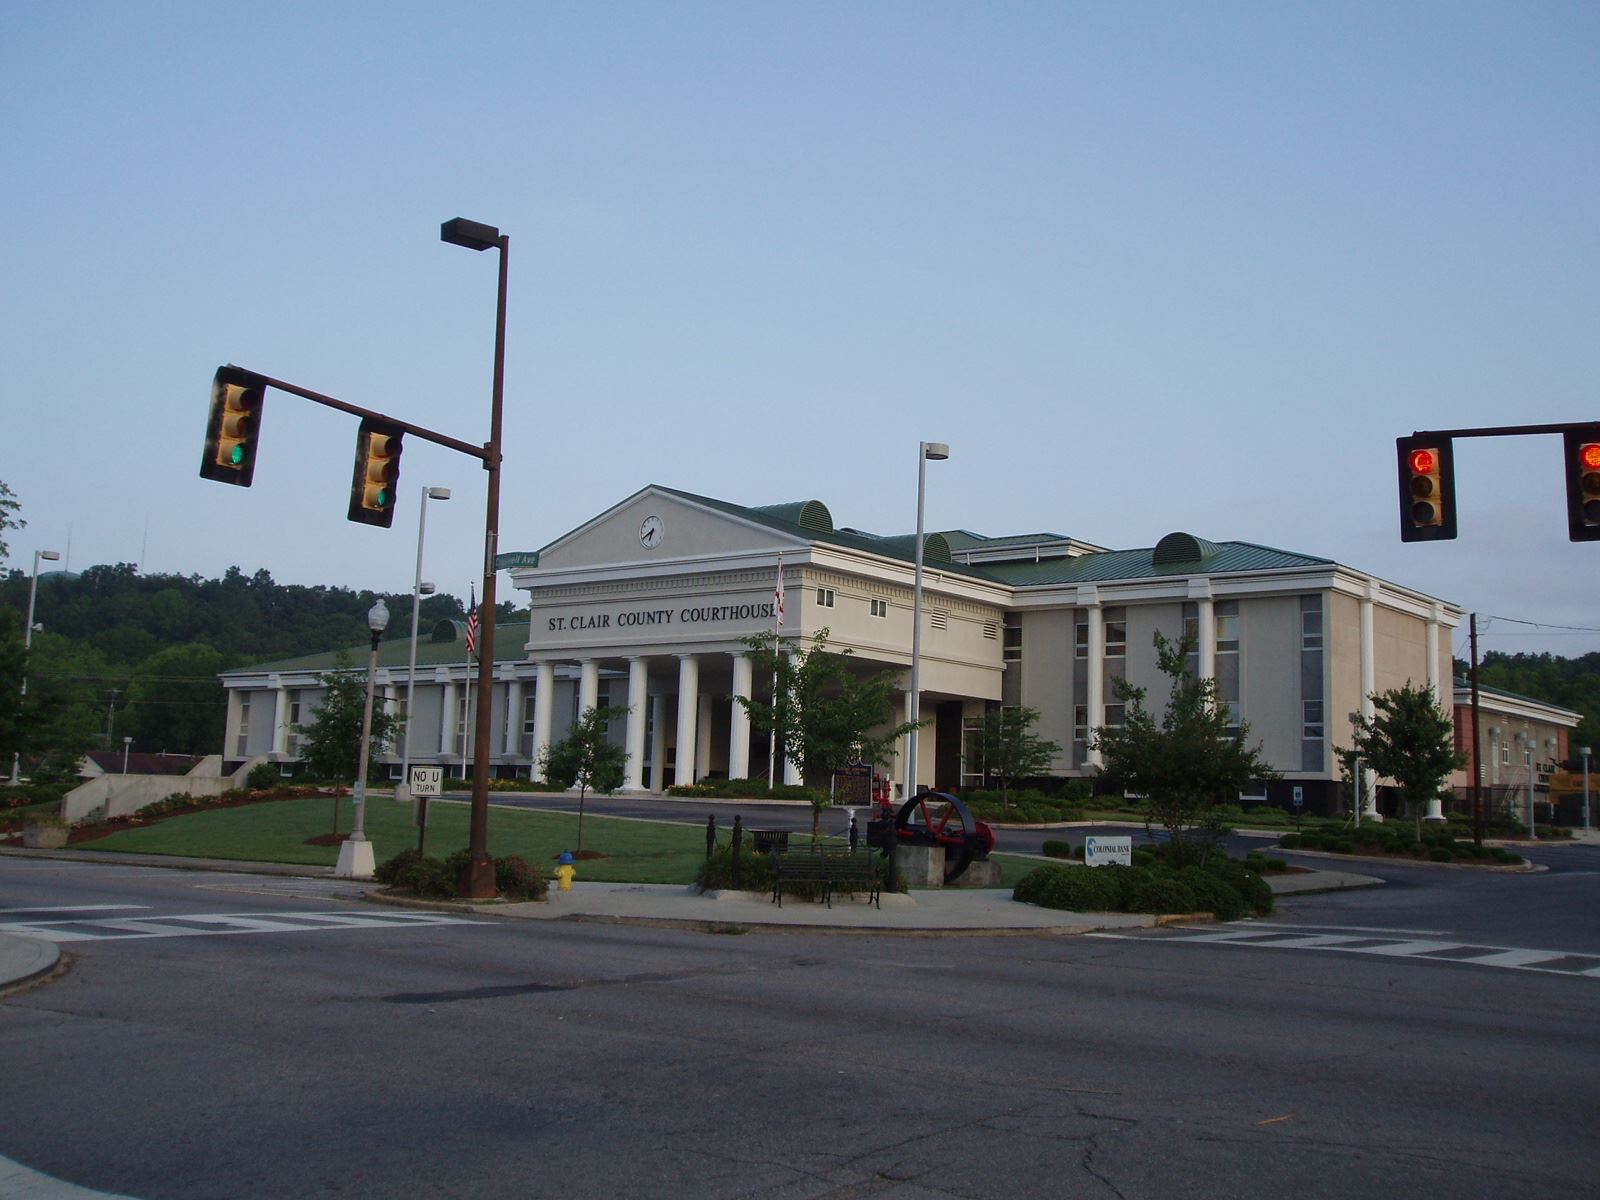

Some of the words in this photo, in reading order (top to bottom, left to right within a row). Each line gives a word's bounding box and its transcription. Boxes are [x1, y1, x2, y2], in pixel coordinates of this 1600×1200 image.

[549, 617, 567, 631] ST.
[570, 614, 610, 630] CLAIR
[617, 610, 674, 627] COUNTY
[680, 603, 777, 623] COURTHOUSE
[413, 770, 427, 782] NO
[432, 771, 439, 782] U
[416, 784, 435, 792] TURN
[1094, 845, 1116, 854] COLONIAL
[1117, 845, 1130, 853] BANK
